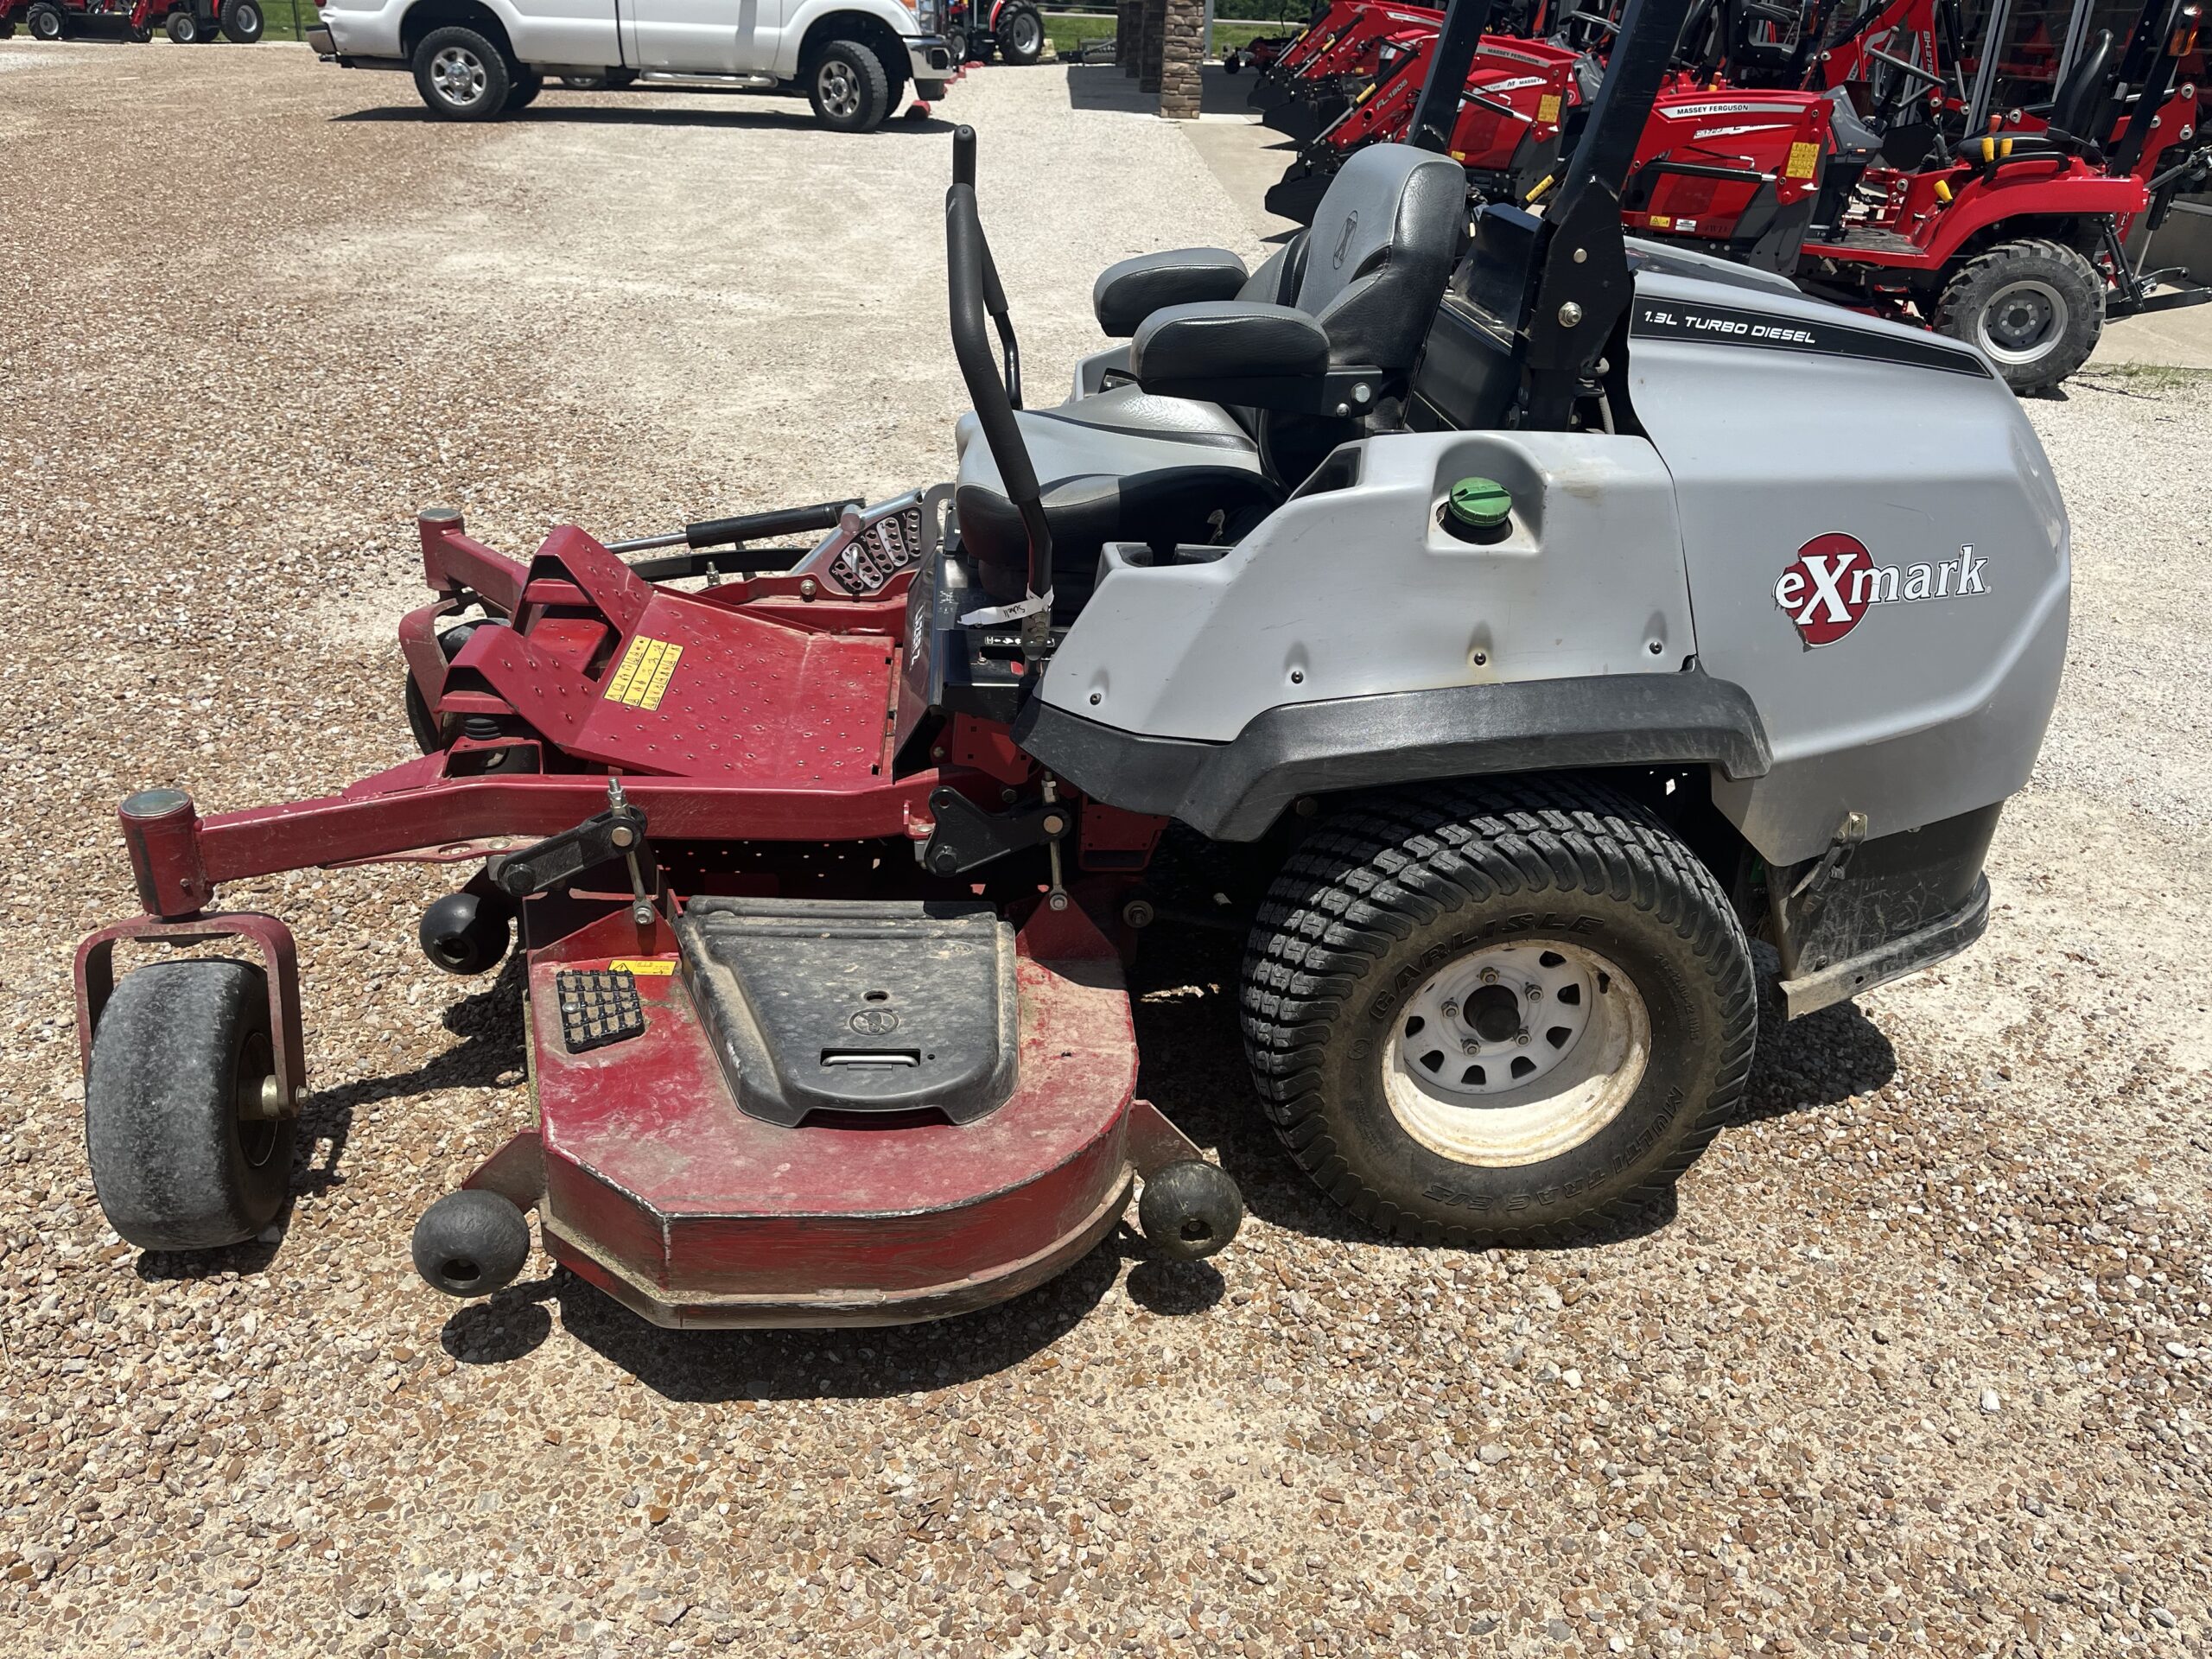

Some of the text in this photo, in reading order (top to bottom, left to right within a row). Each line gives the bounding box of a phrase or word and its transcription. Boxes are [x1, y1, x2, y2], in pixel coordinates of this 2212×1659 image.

[1676, 106, 1707, 115] MASSEY
[1644, 310, 1815, 345] 1.3L TURBO DIESEL
[1369, 912, 1605, 1019] CARLISLE
[1612, 1084, 1684, 1174] MULTI
